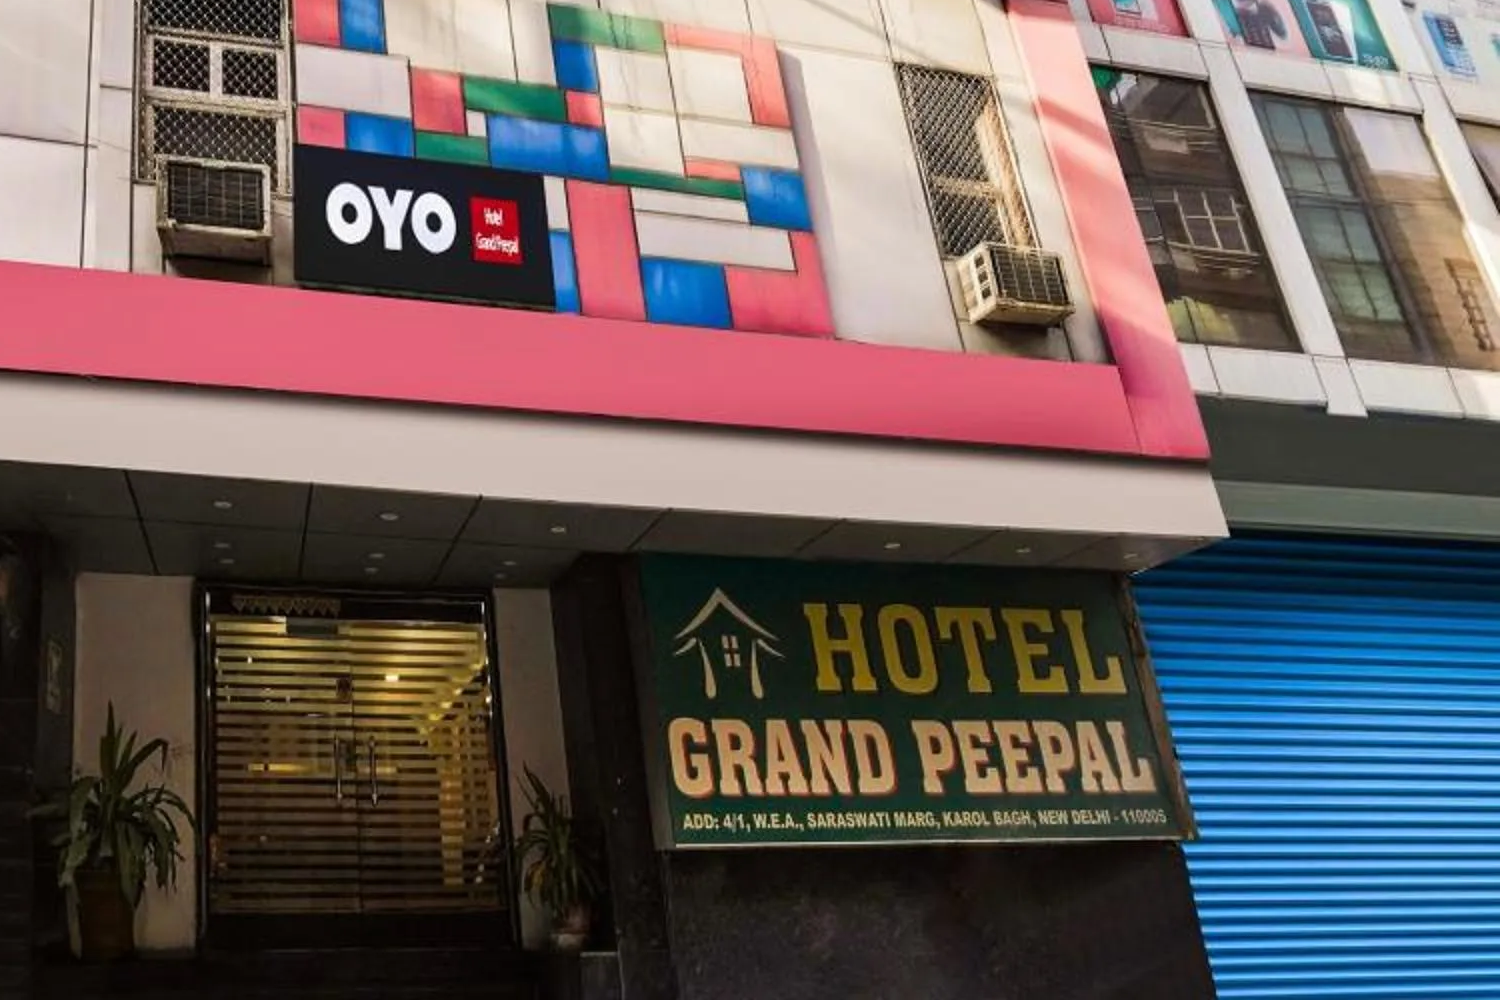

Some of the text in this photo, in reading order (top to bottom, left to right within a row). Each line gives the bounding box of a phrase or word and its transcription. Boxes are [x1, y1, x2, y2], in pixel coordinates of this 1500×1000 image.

[326, 182, 457, 255] OYO
[803, 603, 1128, 695] HOTEL
[668, 718, 1158, 798] GRAND PEEPAL
[683, 812, 720, 829] ADD:
[807, 811, 891, 829] SARASWATI
[893, 810, 941, 829] MARG,
[943, 811, 991, 827] KAROL
[993, 810, 1037, 829] BAGH,
[1038, 809, 1069, 825] NEW
[1072, 808, 1111, 824] DELHI
